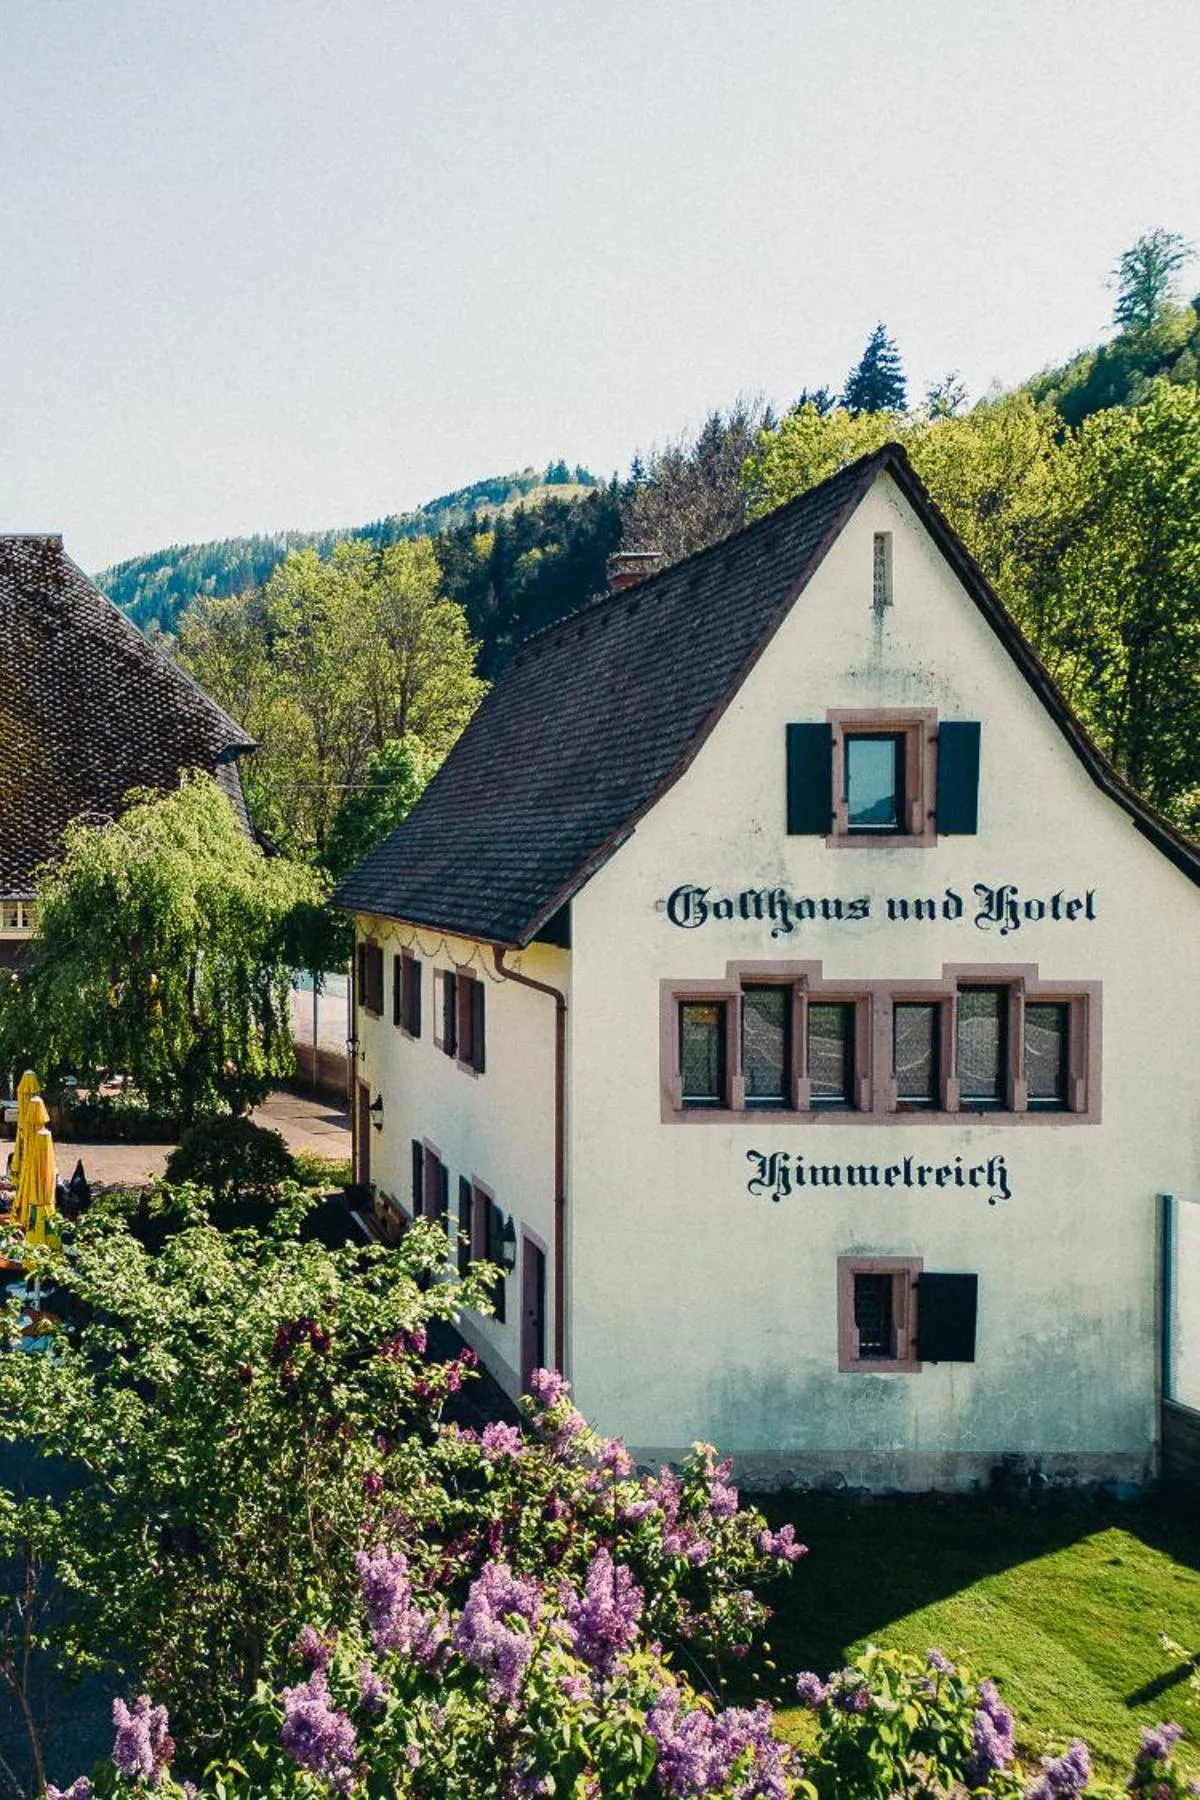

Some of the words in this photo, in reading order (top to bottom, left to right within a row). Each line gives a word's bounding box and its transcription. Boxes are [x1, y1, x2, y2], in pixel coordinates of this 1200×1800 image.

[886, 888, 963, 922] und
[974, 883, 1097, 936] Hotel
[746, 1149, 1012, 1206] Himmelreich
